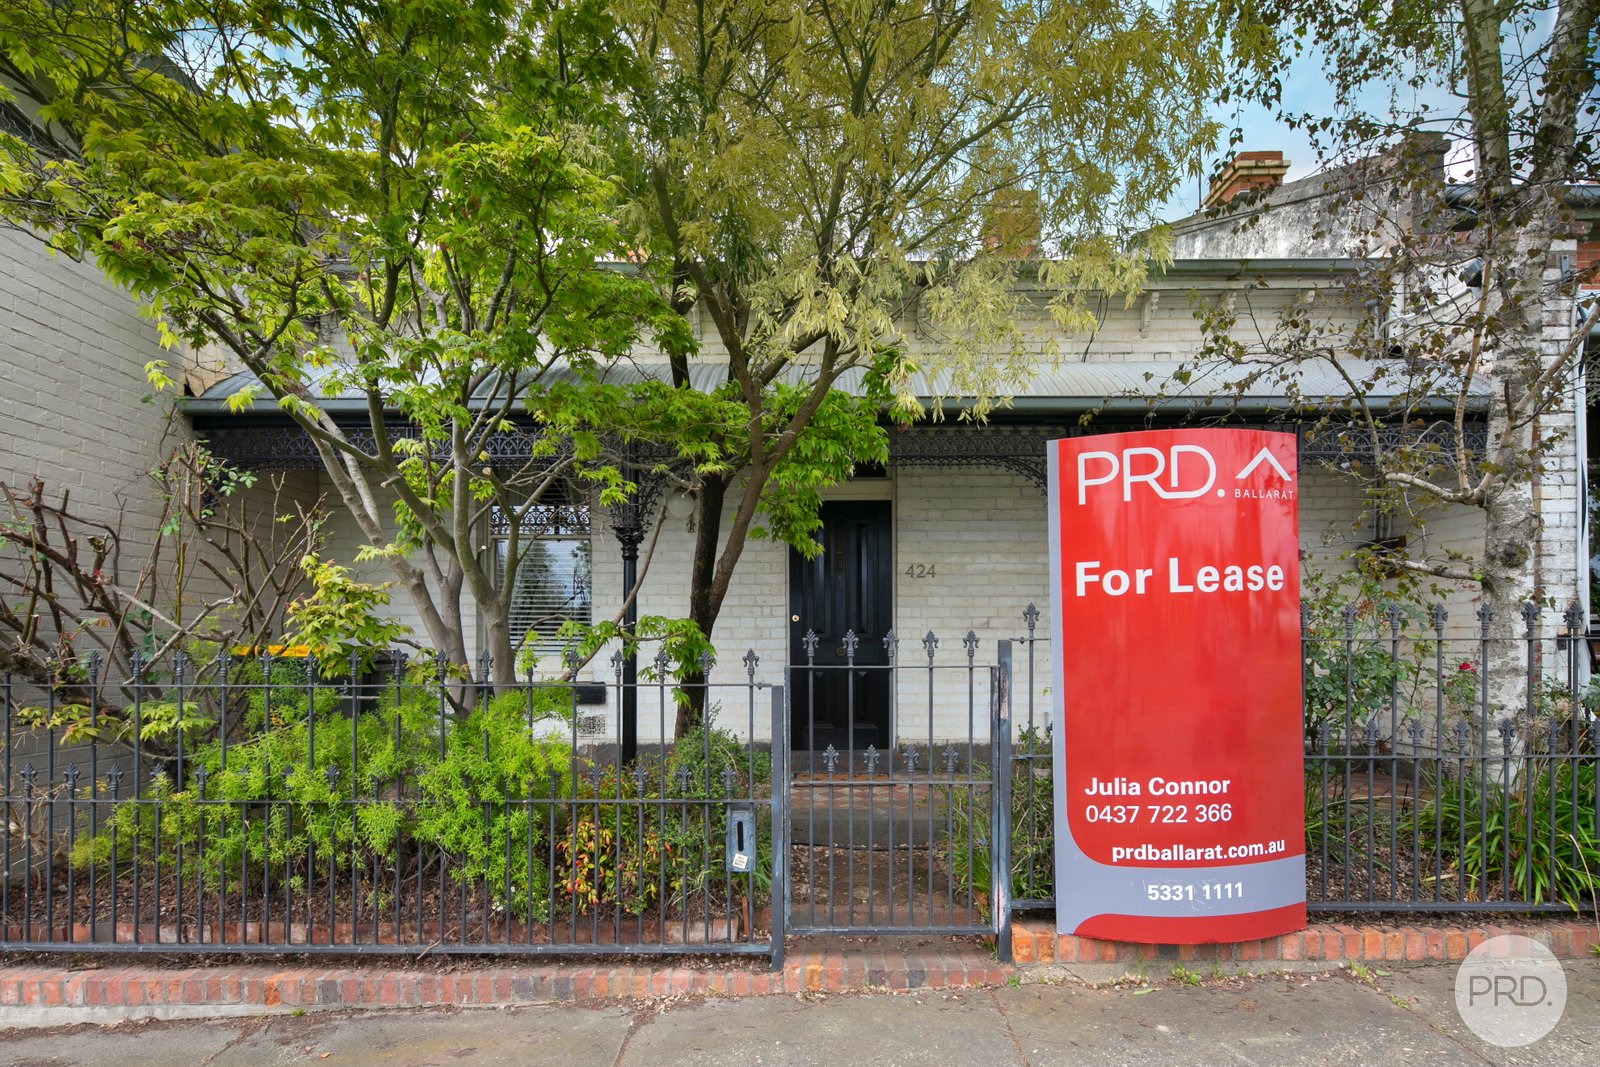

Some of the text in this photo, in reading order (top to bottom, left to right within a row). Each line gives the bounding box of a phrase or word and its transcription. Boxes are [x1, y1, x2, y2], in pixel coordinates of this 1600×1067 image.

[1234, 488, 1294, 500] BALLARAT
[904, 563, 936, 579] 424
[1075, 557, 1284, 597] For Lease
[1084, 776, 1231, 796] Julia Connor
[1085, 803, 1232, 824] 0437 722 366
[1112, 839, 1285, 863] prdballarat.com.au
[1147, 881, 1244, 901] 5331 1111
